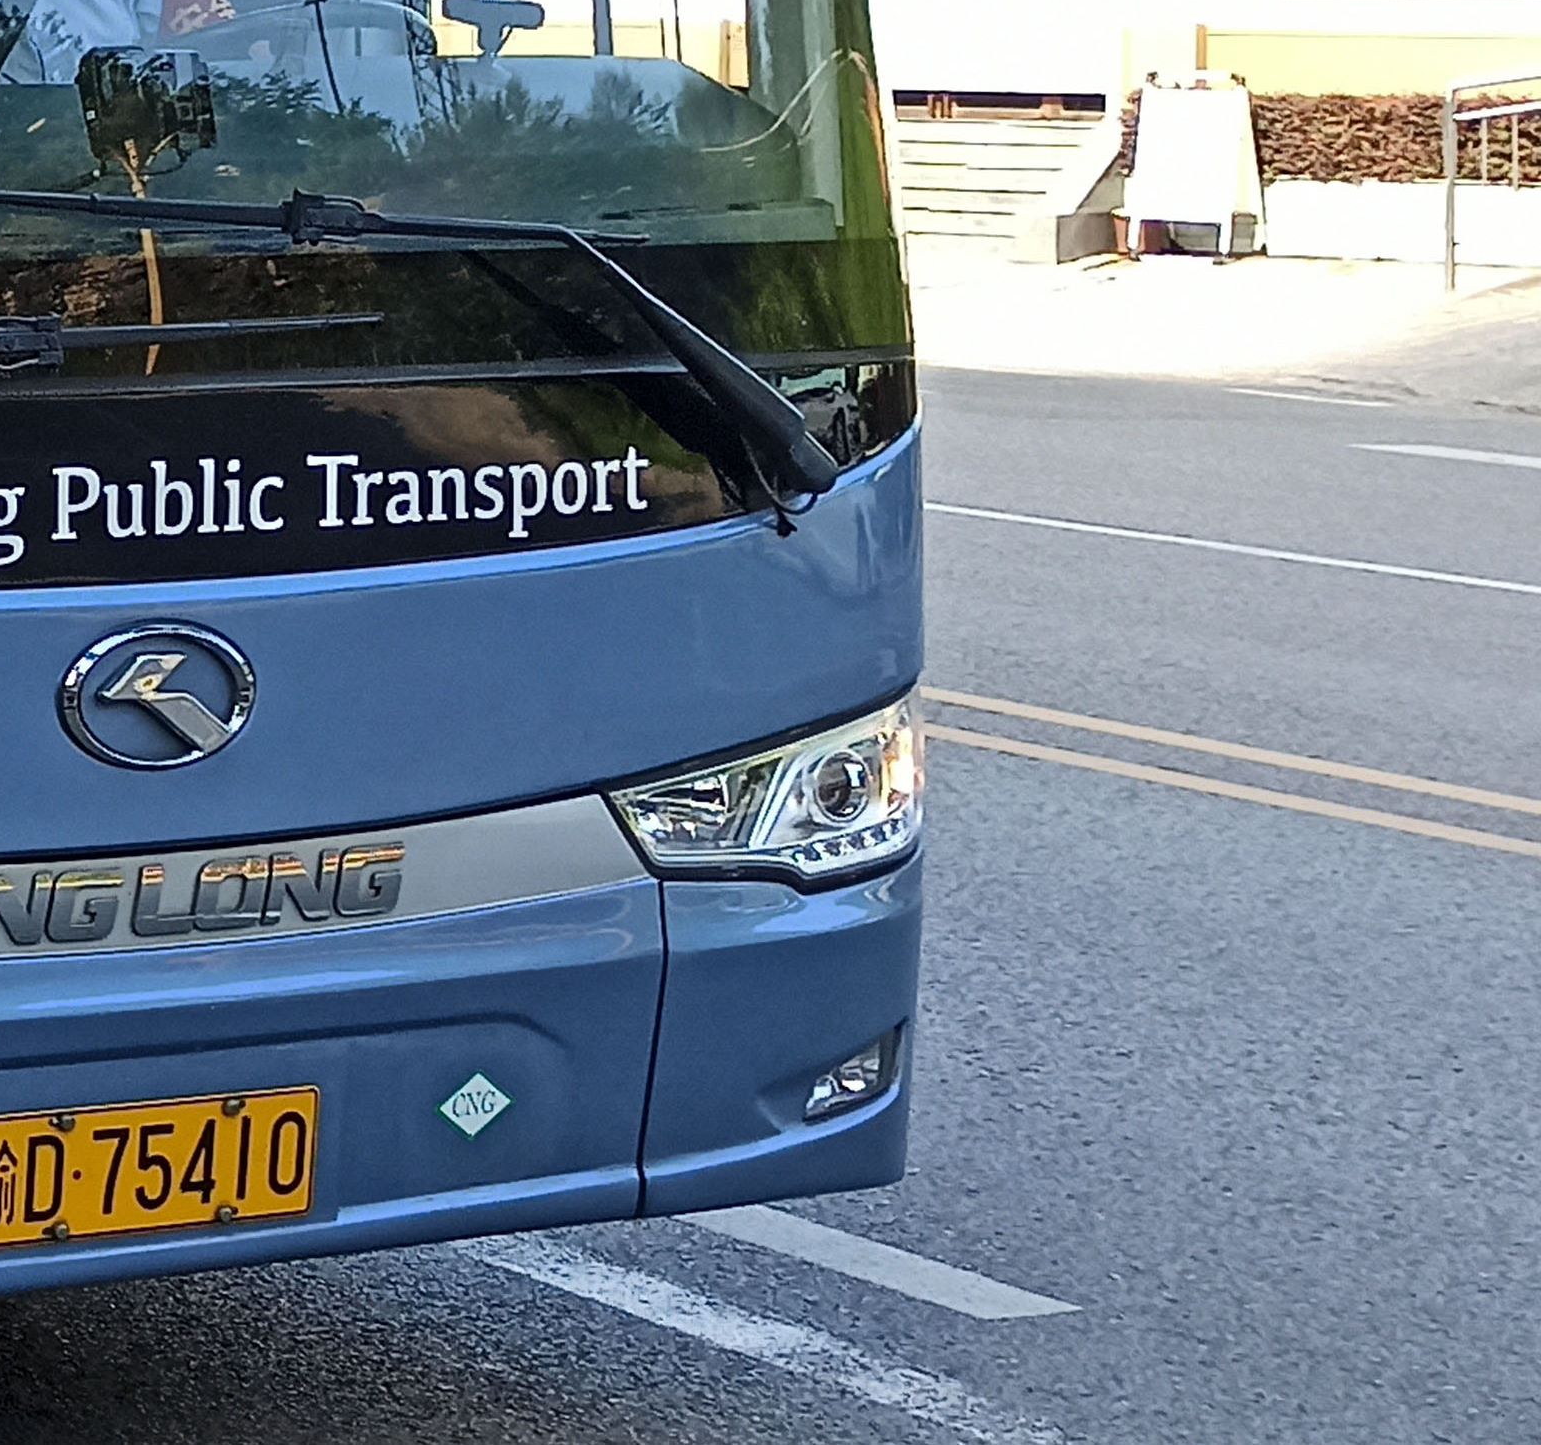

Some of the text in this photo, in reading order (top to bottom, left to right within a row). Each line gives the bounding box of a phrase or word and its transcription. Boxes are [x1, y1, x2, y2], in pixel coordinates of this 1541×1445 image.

[51, 457, 285, 541] Public
[305, 444, 650, 537] Transport
[130, 841, 405, 933] LONG
[452, 1090, 495, 1117] CNG
